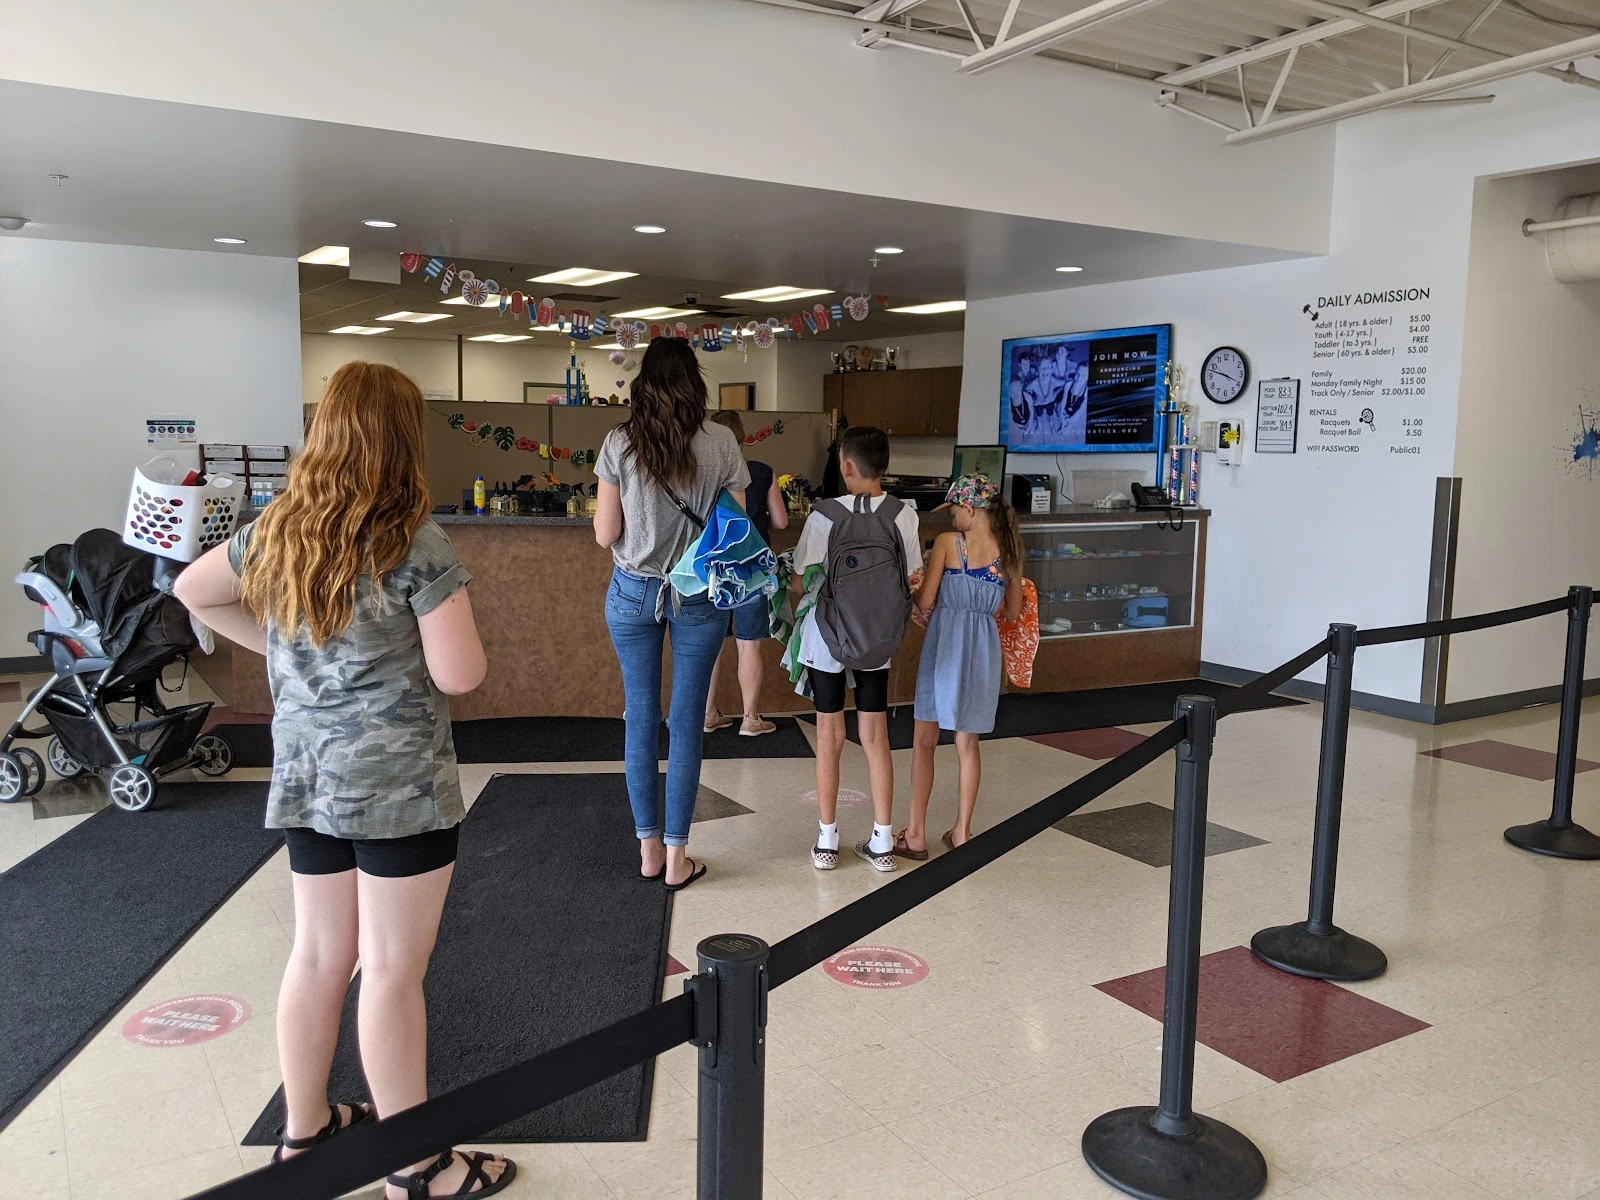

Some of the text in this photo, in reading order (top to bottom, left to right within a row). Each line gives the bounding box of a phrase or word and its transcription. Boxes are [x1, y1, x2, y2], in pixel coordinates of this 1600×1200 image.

[1318, 288, 1430, 308] DAILY ADMISSION
[1410, 314, 1431, 323] $5.00
[1315, 320, 1333, 329] Adult
[1409, 325, 1430, 333] $4.00
[1314, 331, 1333, 339] Youth
[1412, 336, 1429, 344] FREE
[1314, 340, 1340, 349] Toddler
[1407, 345, 1428, 354] $3.00
[1093, 351, 1148, 361] JOIN NOW
[1223, 353, 1230, 361] 12
[1313, 350, 1335, 358] Senior
[1239, 370, 1244, 378] 3
[1311, 370, 1333, 379] Family
[1401, 366, 1427, 375] $20.00
[1208, 372, 1213, 380] 9
[1210, 381, 1215, 389] 8
[1311, 378, 1383, 389] Monday Family Night
[1216, 387, 1221, 395] 7
[1223, 389, 1228, 397] 6
[1231, 386, 1236, 394] 5
[1311, 389, 1329, 397] Track
[1330, 389, 1346, 398] Only
[1351, 388, 1375, 396] Senior
[1381, 387, 1426, 396] $2.00/$1.00
[1320, 418, 1351, 427] Racquets
[1402, 418, 1423, 427] $1.00
[1320, 428, 1361, 437] Racquet Ball
[1406, 429, 1422, 437] $.50
[1321, 445, 1360, 453] PASSWORD
[1390, 446, 1421, 454] Public01
[847, 960, 902, 968] PLEASE
[875, 967, 914, 975] HERE
[852, 979, 883, 987] THANK
[163, 1010, 221, 1023] PLEASE
[141, 1016, 221, 1032] WAIT HERE
[135, 1033, 164, 1045] THANK
